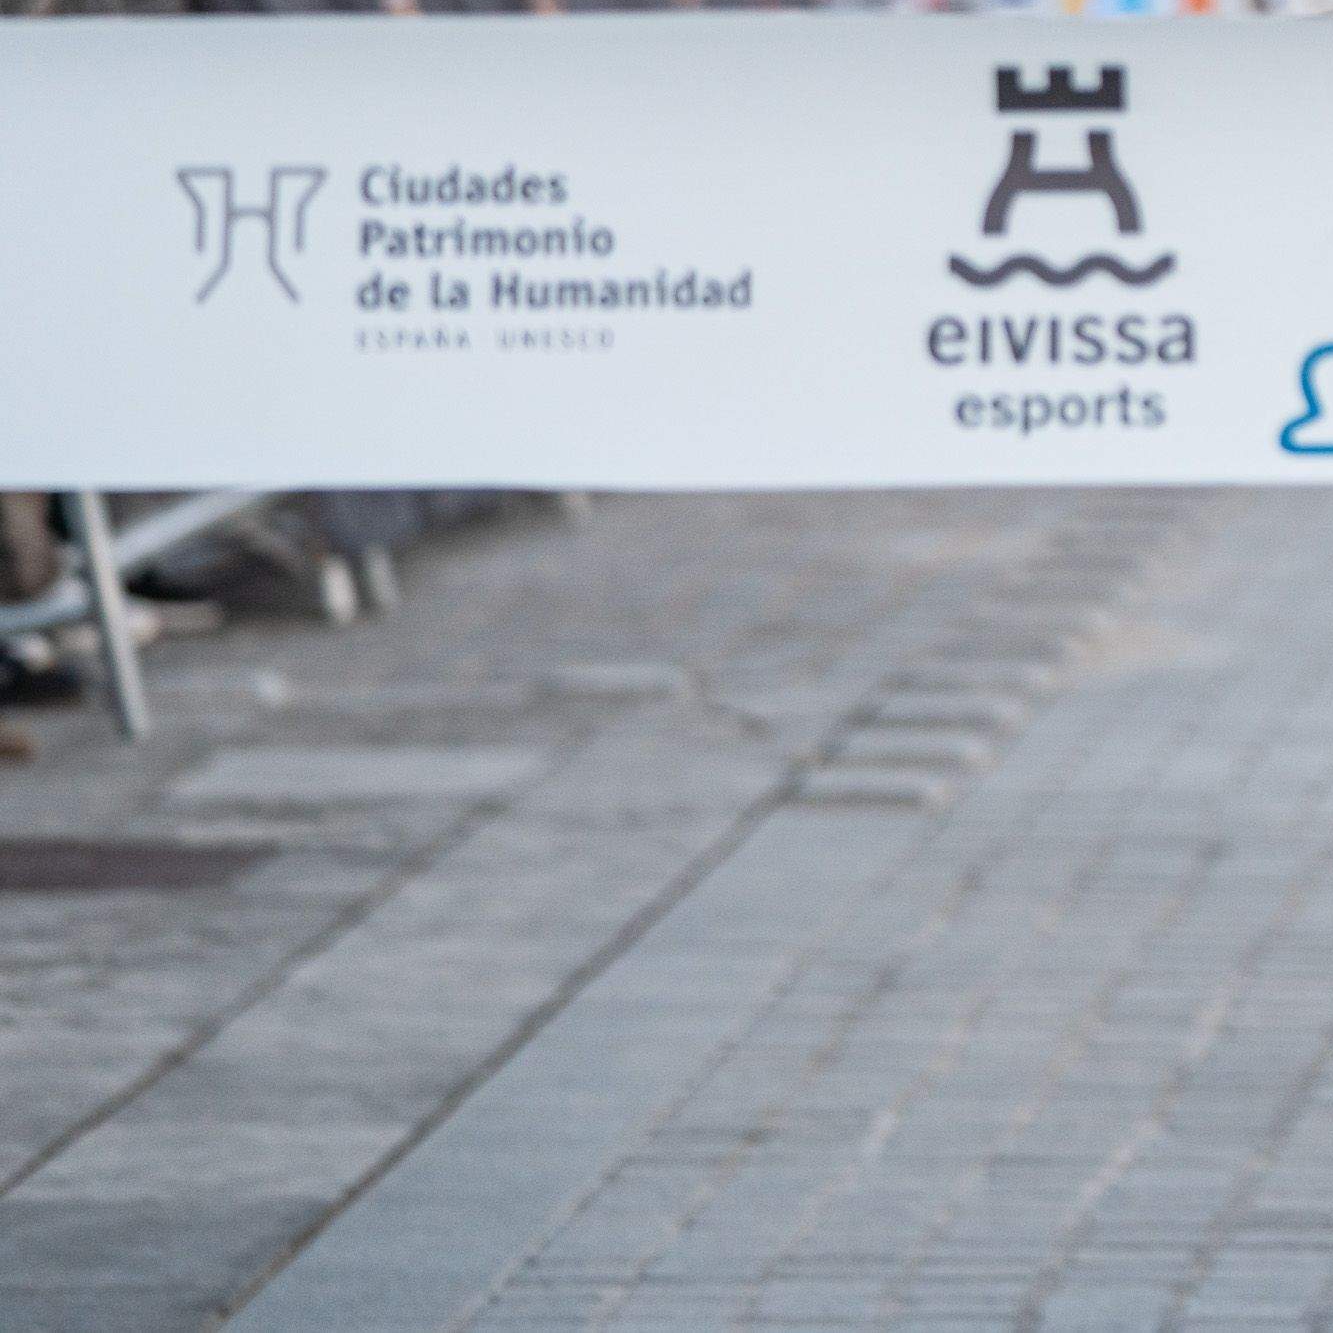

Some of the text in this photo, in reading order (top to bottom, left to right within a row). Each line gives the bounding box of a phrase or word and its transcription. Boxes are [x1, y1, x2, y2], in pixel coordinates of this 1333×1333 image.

[358, 165, 568, 207] Ciudades
[358, 217, 615, 259] Patrimonio
[355, 269, 752, 312] de la Humanidad
[924, 312, 1197, 368] eivissa
[952, 384, 1167, 436] esports
